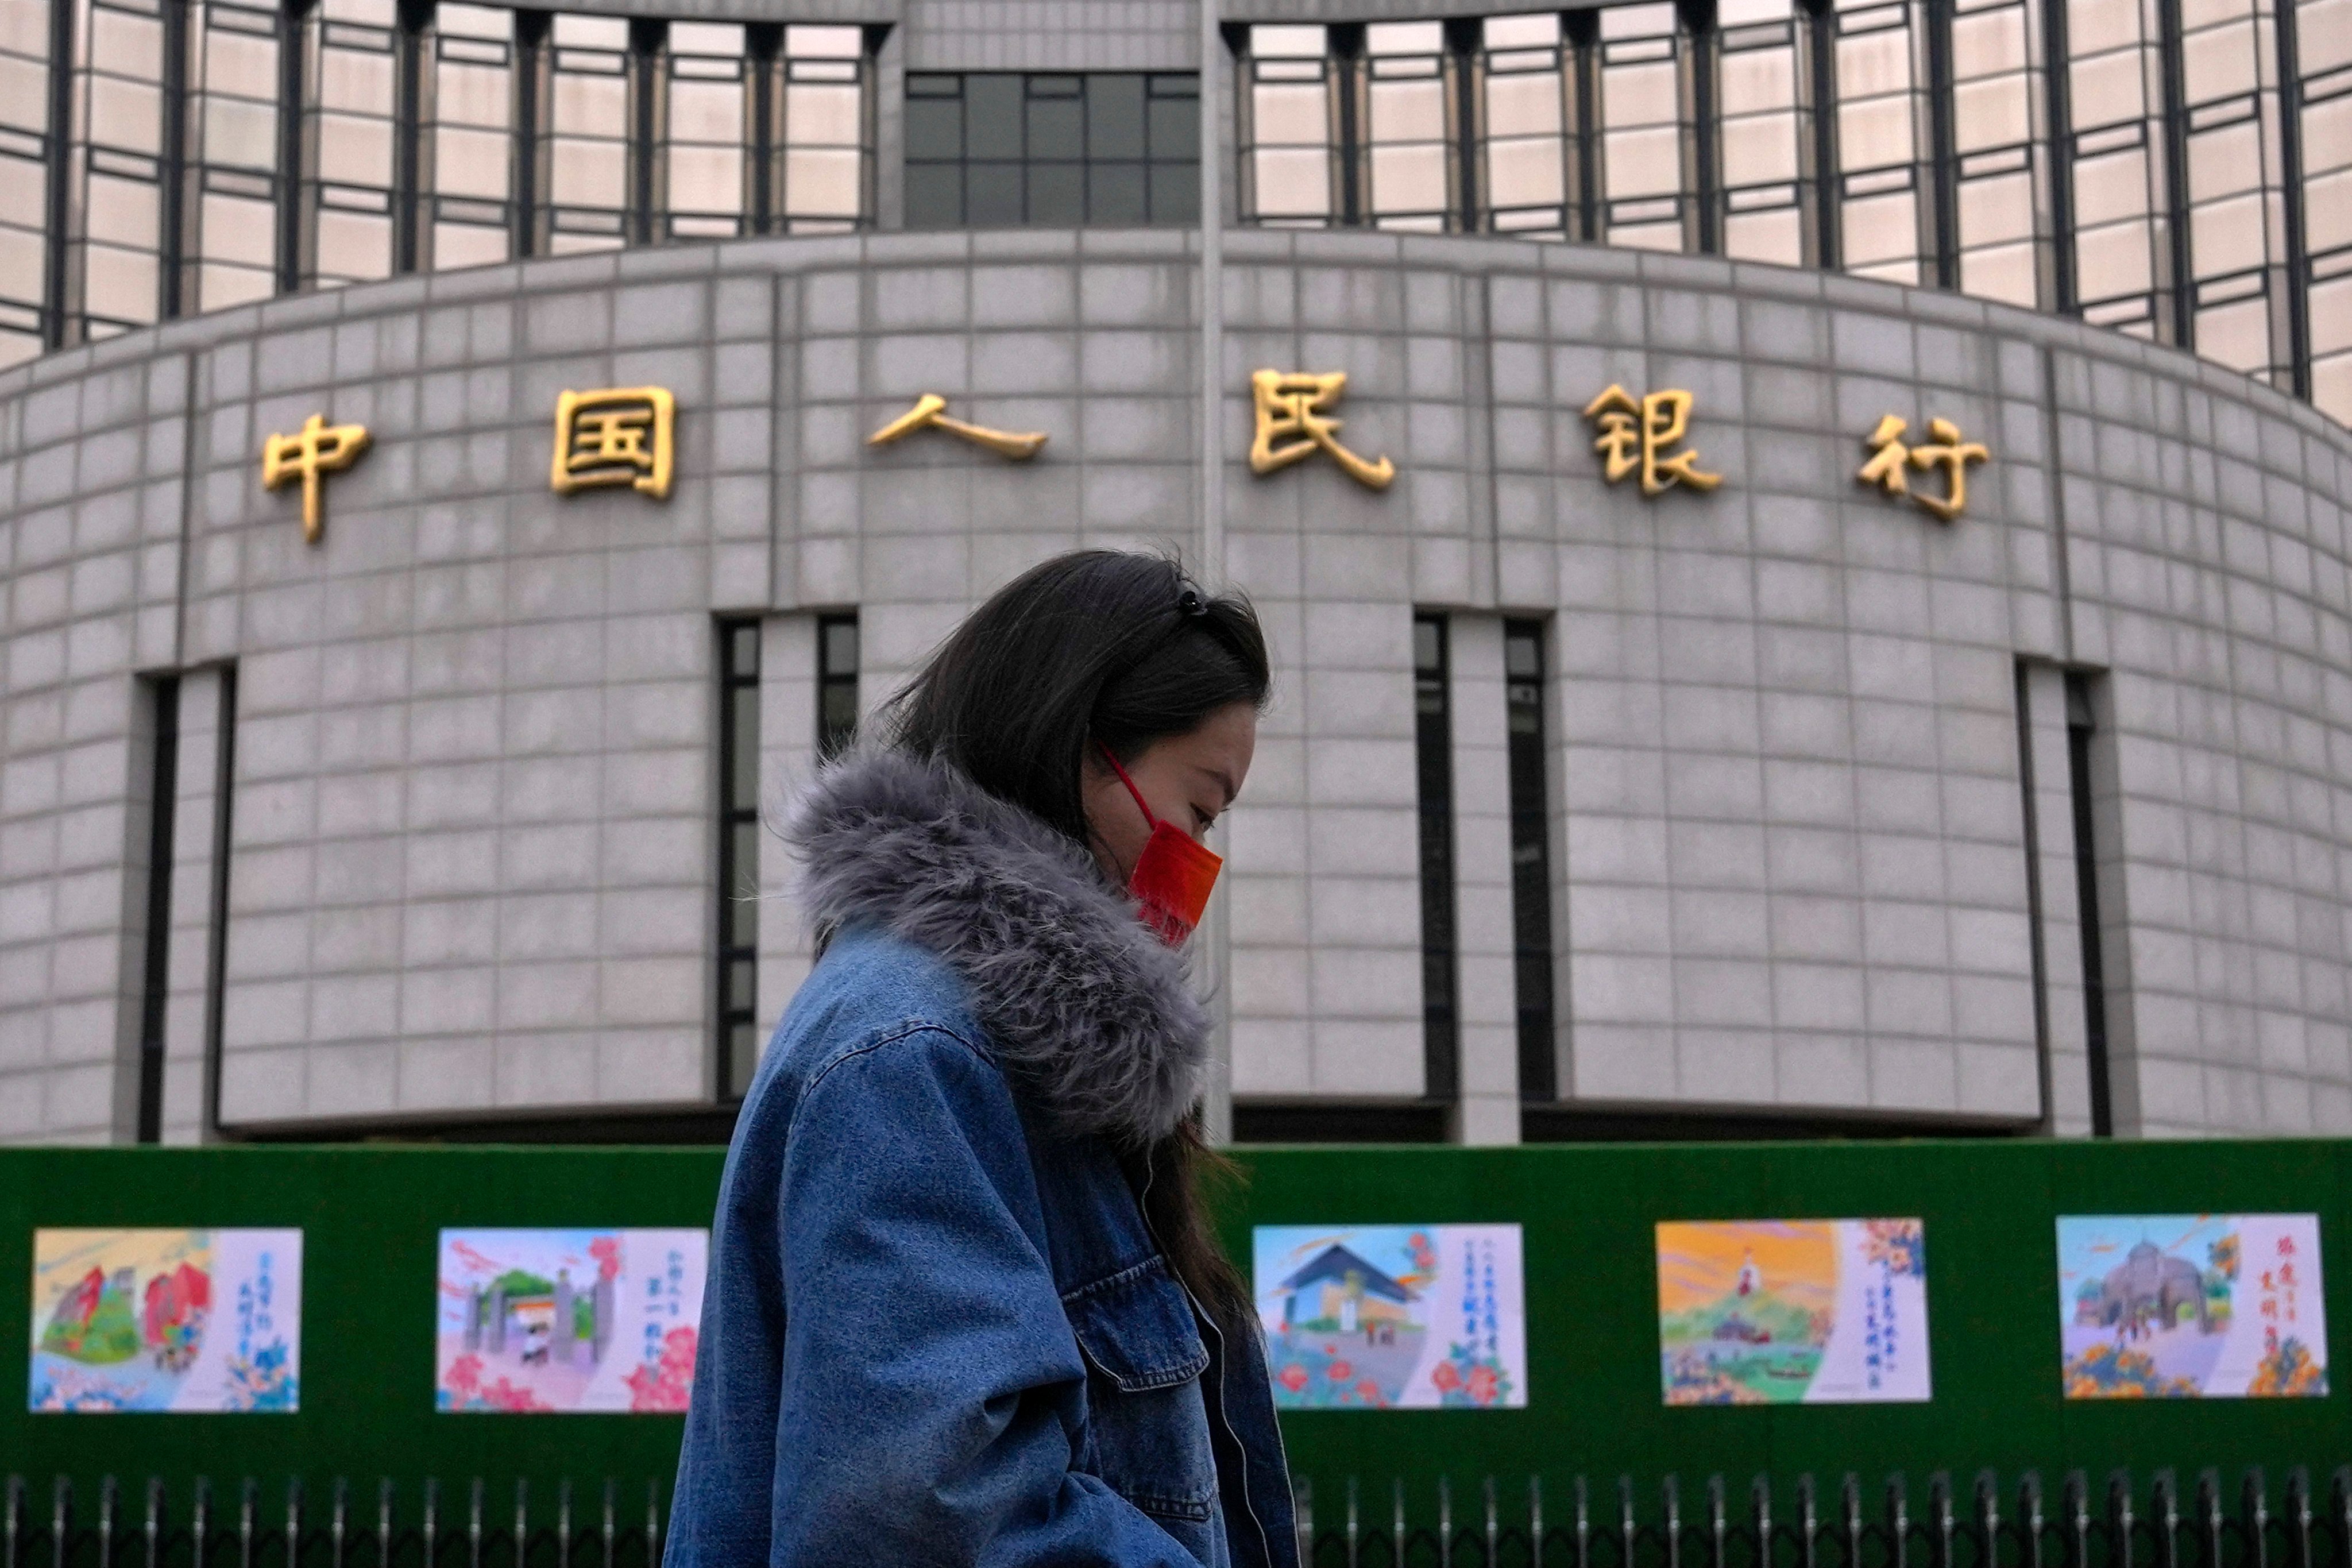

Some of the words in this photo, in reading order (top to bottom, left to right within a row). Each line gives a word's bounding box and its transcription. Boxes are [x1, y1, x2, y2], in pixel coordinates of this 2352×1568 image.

[262, 370, 1988, 543] 中国人民银行
